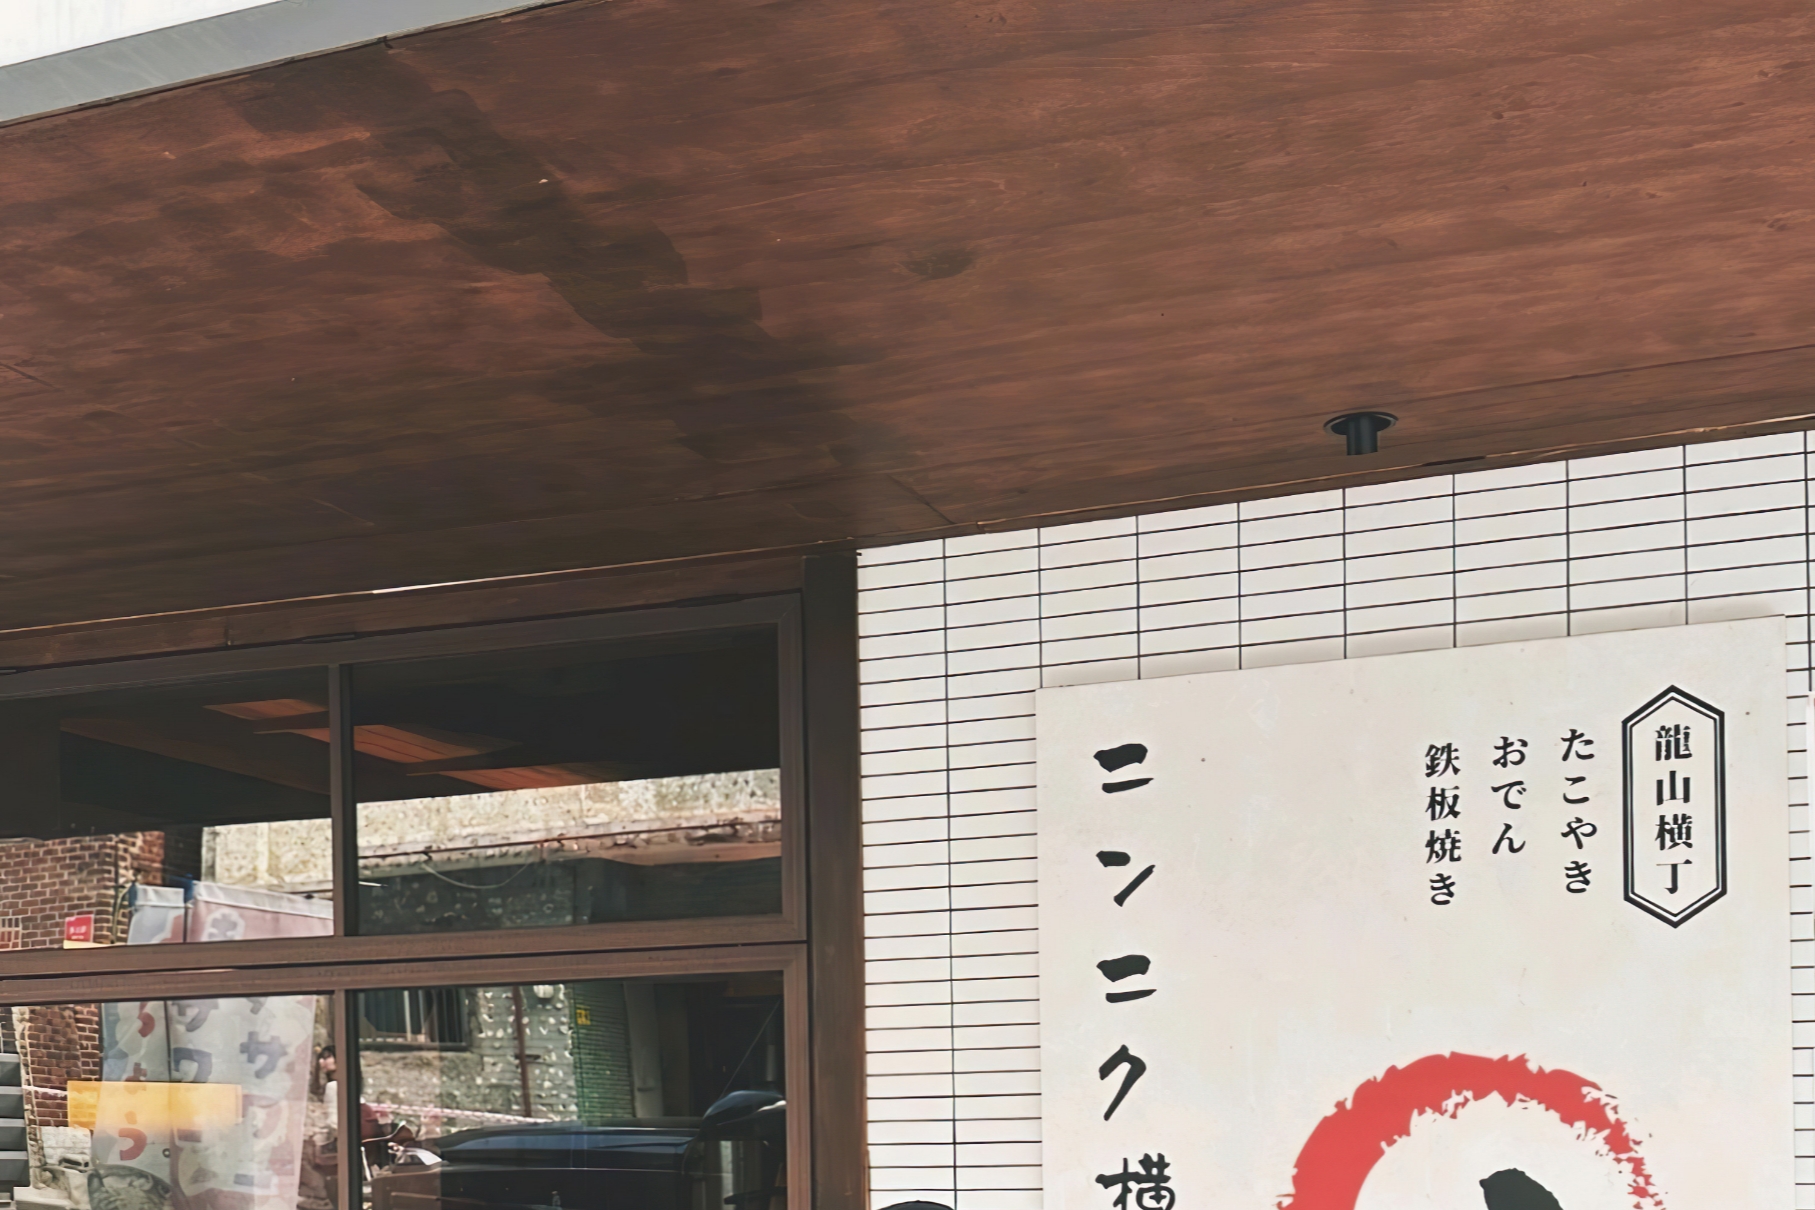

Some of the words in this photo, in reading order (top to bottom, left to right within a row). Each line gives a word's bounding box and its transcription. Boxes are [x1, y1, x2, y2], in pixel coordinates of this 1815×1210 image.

[1425, 742, 1462, 906] 鉄板焼き
[1490, 736, 1529, 856] おでん
[1560, 728, 1598, 894] たこやき
[1653, 724, 1693, 895] 龍山横丁
